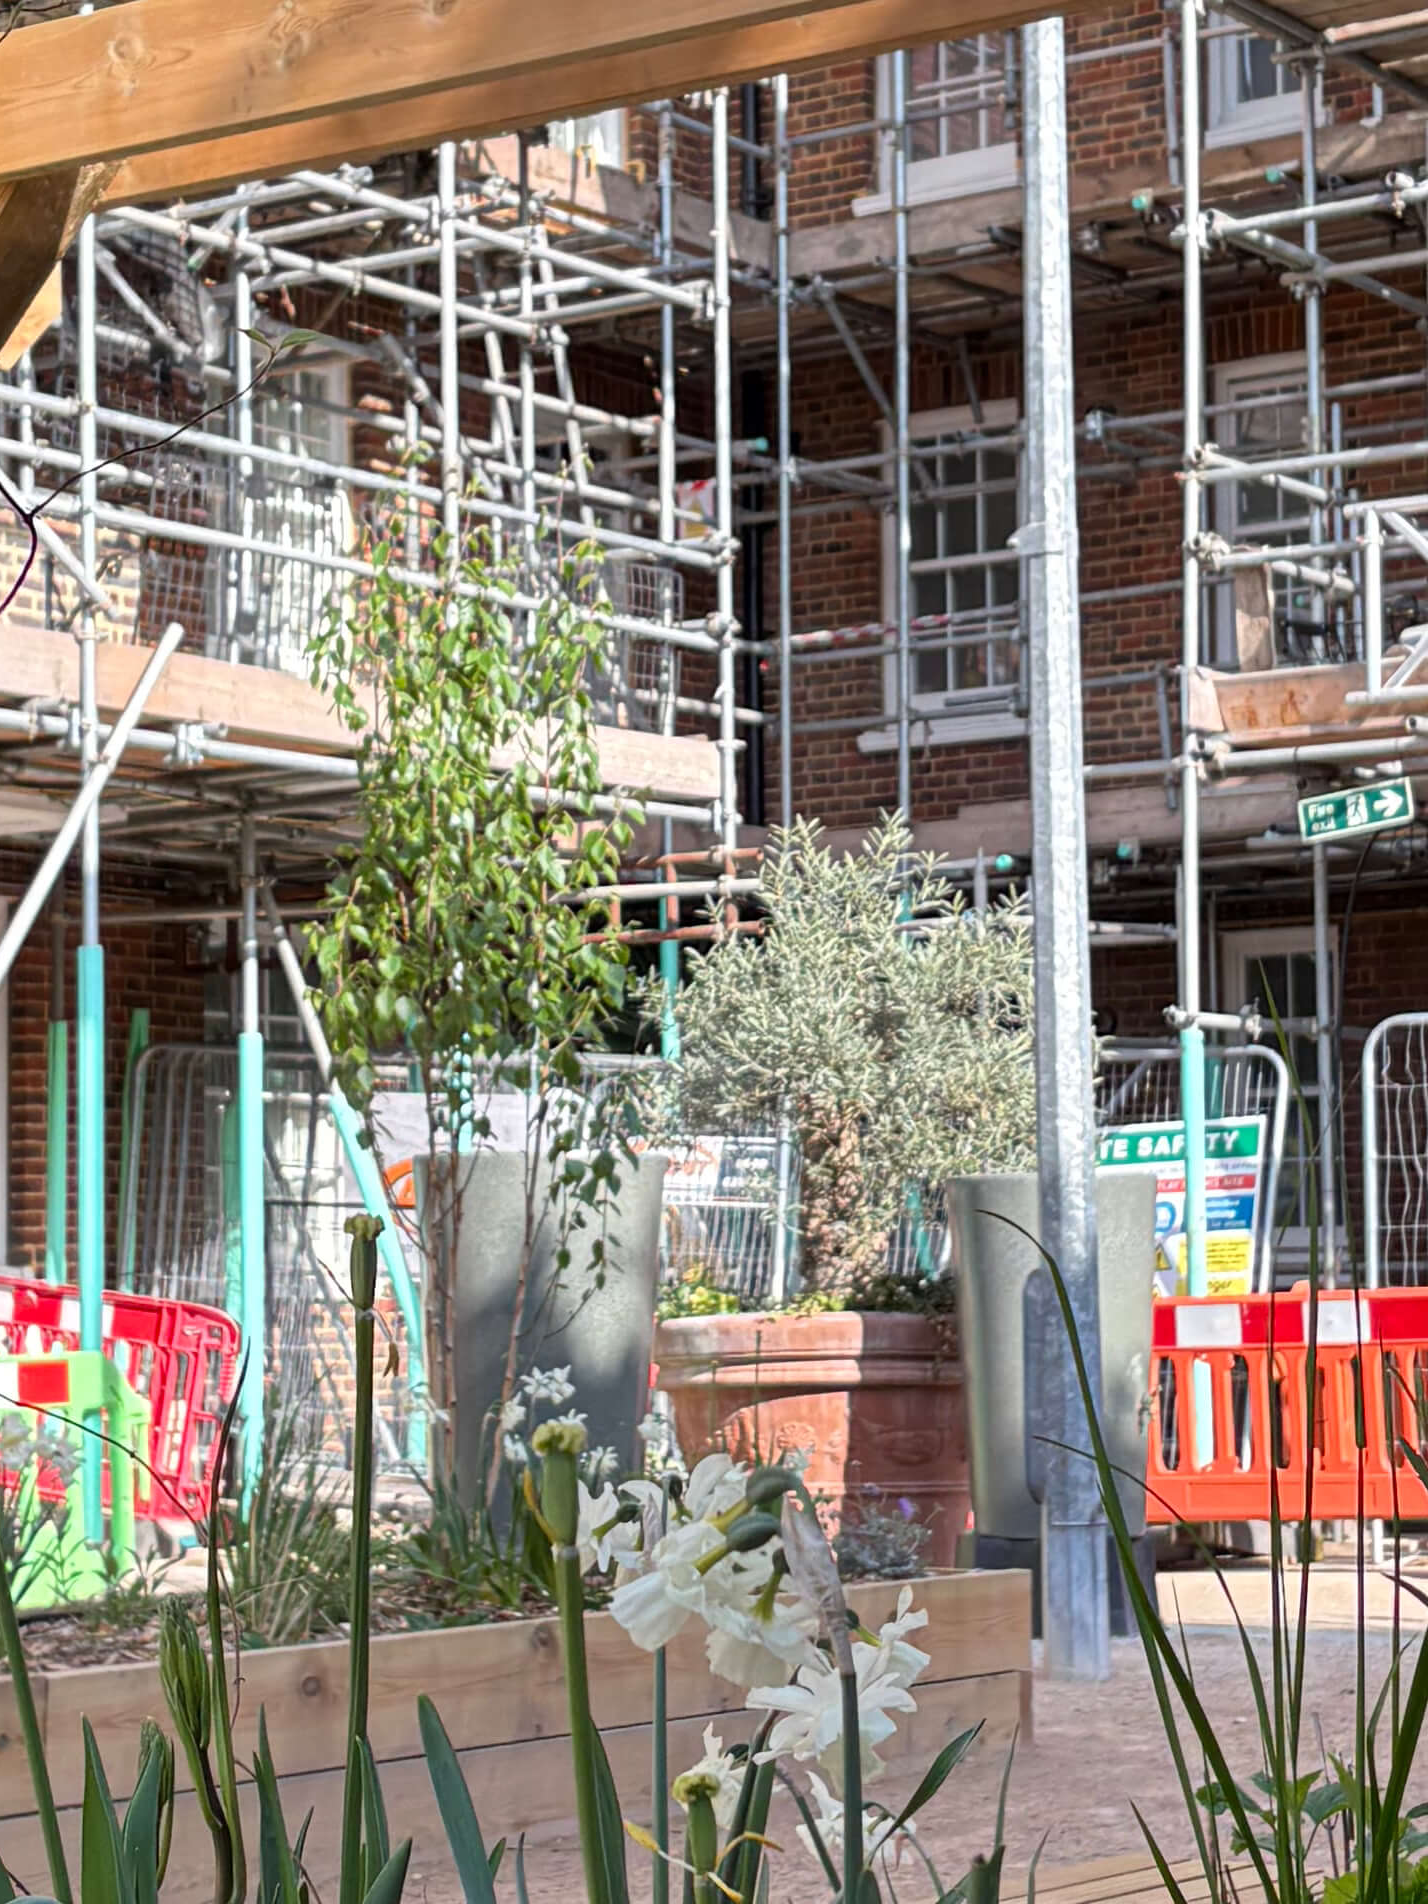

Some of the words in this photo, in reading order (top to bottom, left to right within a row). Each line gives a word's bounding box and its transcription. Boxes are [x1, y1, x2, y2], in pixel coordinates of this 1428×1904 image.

[1307, 803, 1335, 821] Fire
[1312, 817, 1337, 833] exit
[1099, 1138, 1129, 1160] TE
[1136, 1130, 1240, 1158] SAFTY
